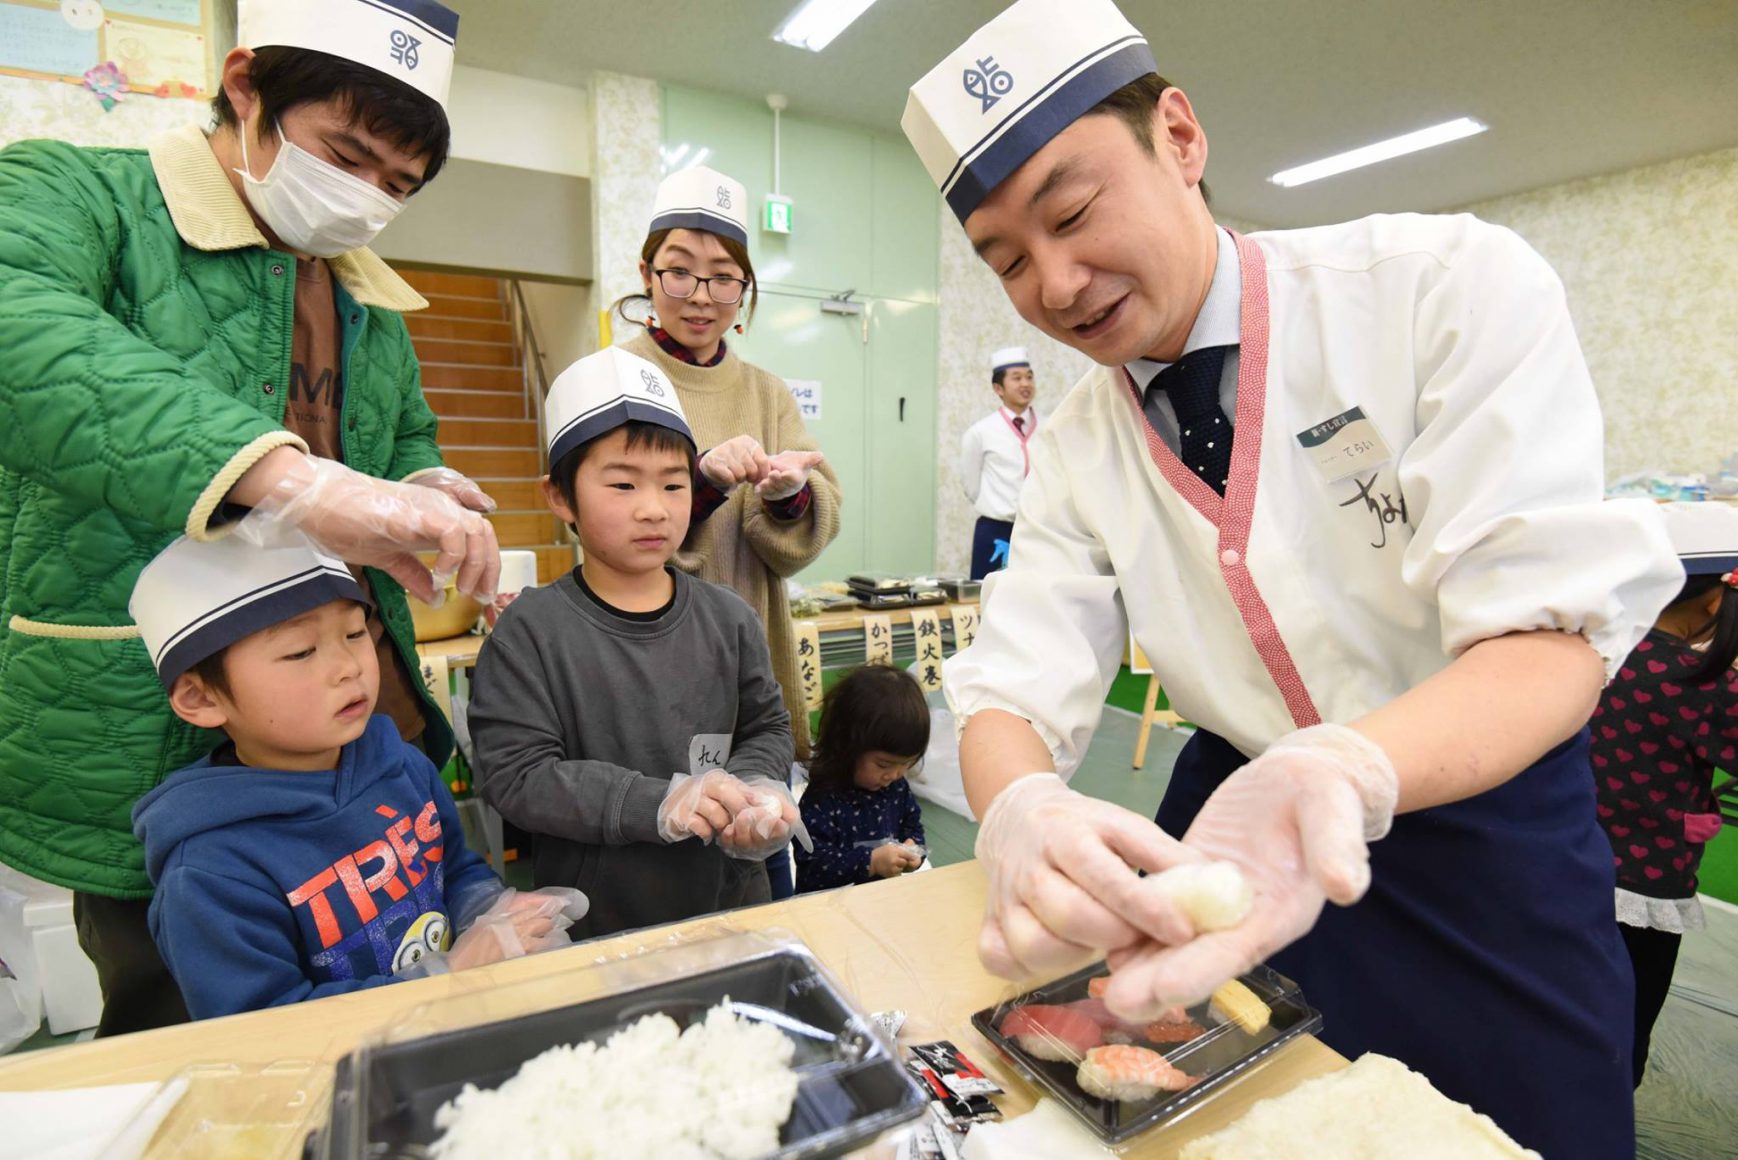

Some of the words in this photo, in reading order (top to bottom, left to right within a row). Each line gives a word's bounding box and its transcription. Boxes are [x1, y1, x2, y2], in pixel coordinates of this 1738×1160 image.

[1343, 440, 1374, 457] てらい
[799, 637, 817, 700] あなご
[918, 618, 941, 686] 鉄火巻
